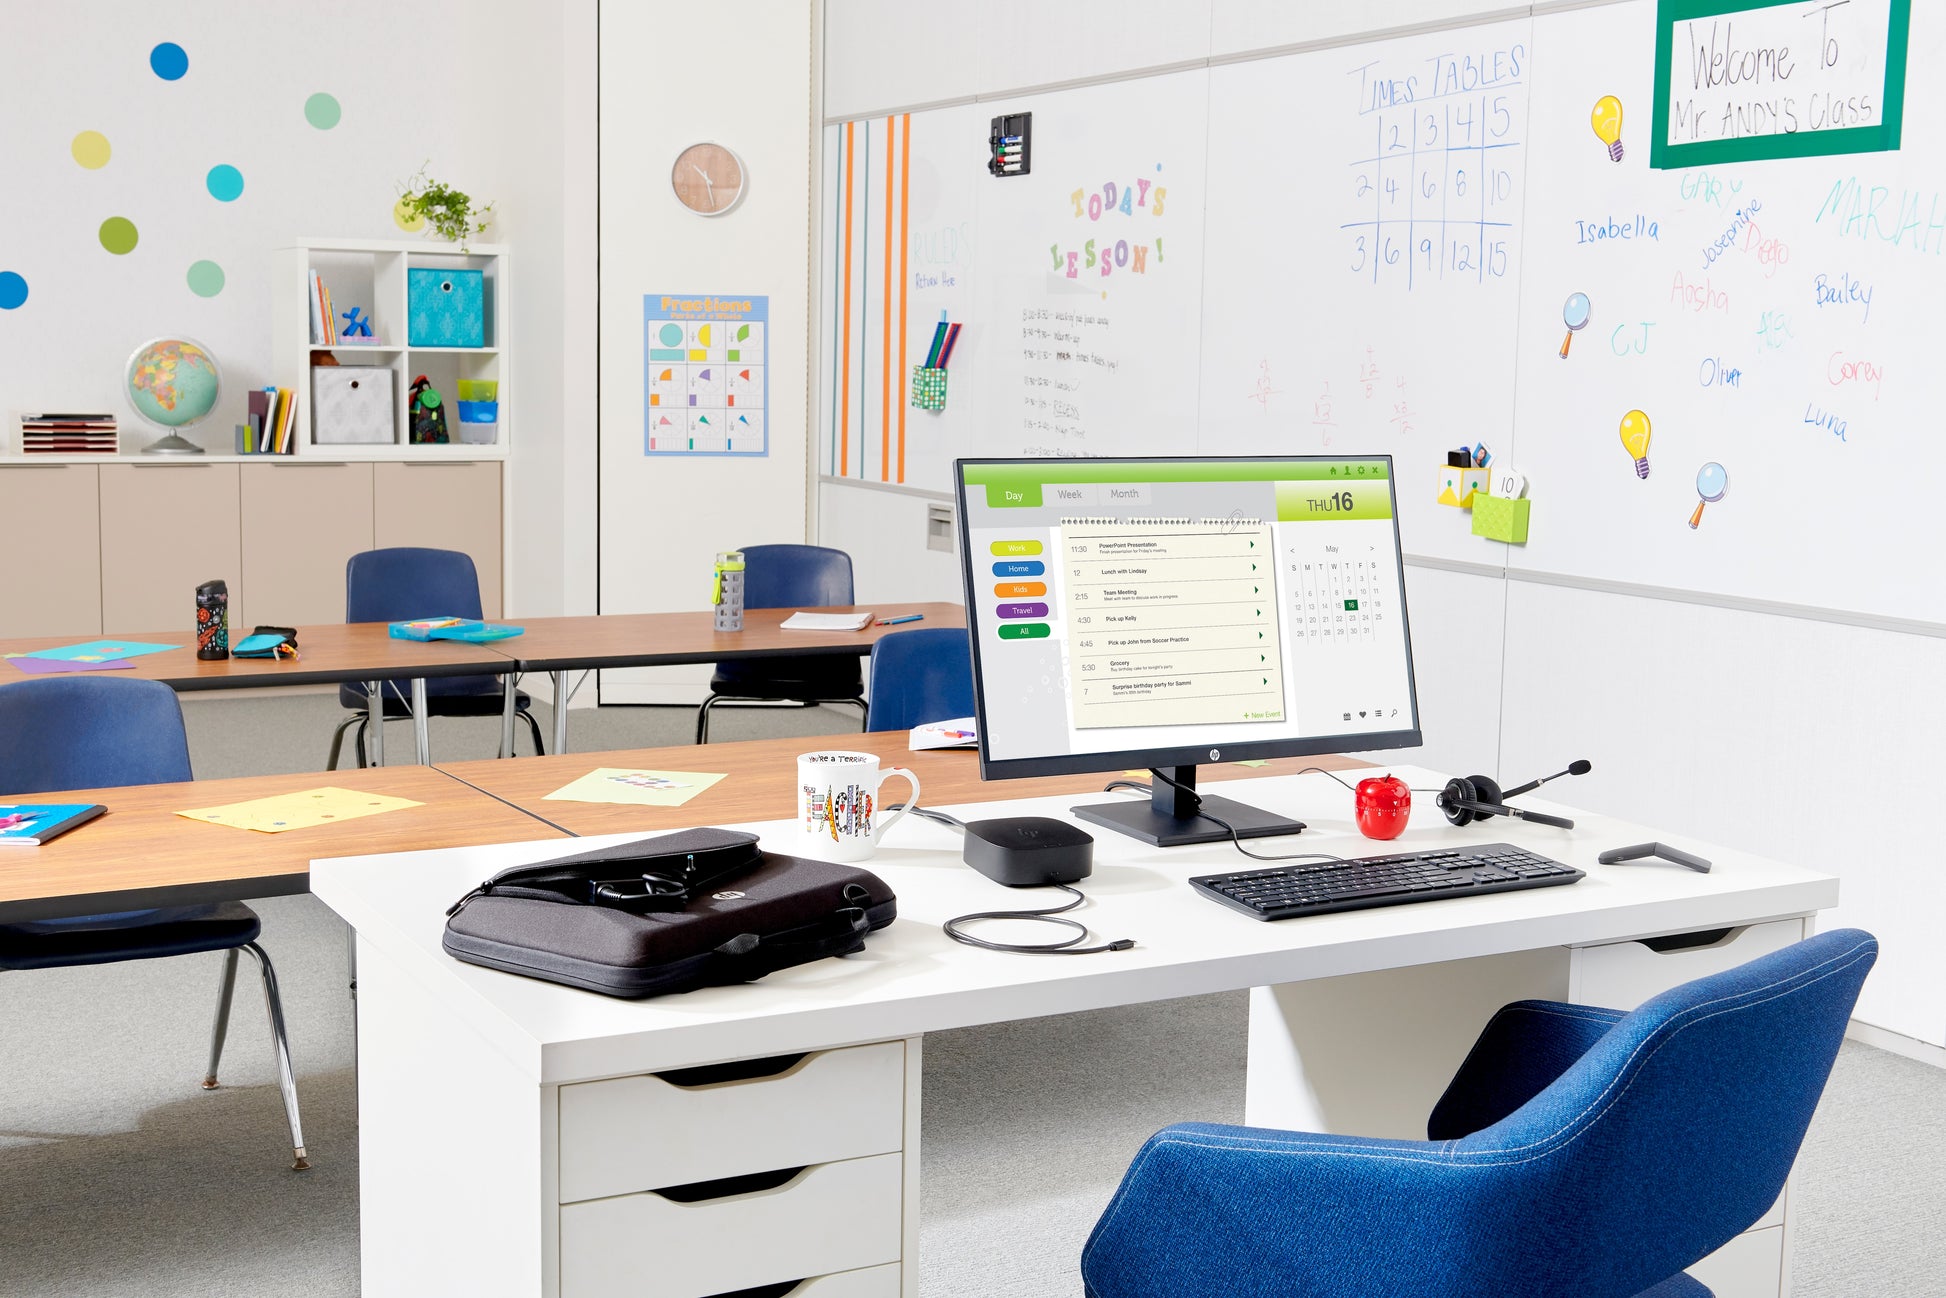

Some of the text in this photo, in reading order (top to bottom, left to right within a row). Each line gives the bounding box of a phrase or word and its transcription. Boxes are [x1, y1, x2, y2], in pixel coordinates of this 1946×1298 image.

[1689, 0, 1850, 90] Welcome To
[1347, 45, 1524, 114] TIMES TABLES
[1389, 97, 1510, 150] 2 3 4 5
[1674, 93, 1872, 139] Mr. ANDY'S Class
[1356, 169, 1511, 206] 2 4 6 8 10
[1577, 215, 1659, 244] Isabella
[1351, 236, 1507, 277] 3 6 9 12 15
[661, 296, 752, 313] Fractions
[1814, 271, 1873, 324] Bailey
[1611, 322, 1656, 356] CJ
[1700, 357, 1742, 388] Oliver
[1828, 351, 1883, 401] Corey
[1804, 402, 1848, 442] Luna
[1006, 491, 1023, 502] Day
[1058, 490, 1082, 499] Week
[1111, 489, 1139, 498] Month
[1501, 477, 1514, 494] 10
[1007, 544, 1026, 552] Work
[1325, 545, 1339, 554] May
[1008, 565, 1029, 573] Home
[1012, 607, 1033, 615] Travel
[1020, 627, 1029, 635] All
[1210, 749, 1220, 761] hp
[804, 785, 873, 843] TEACHER
